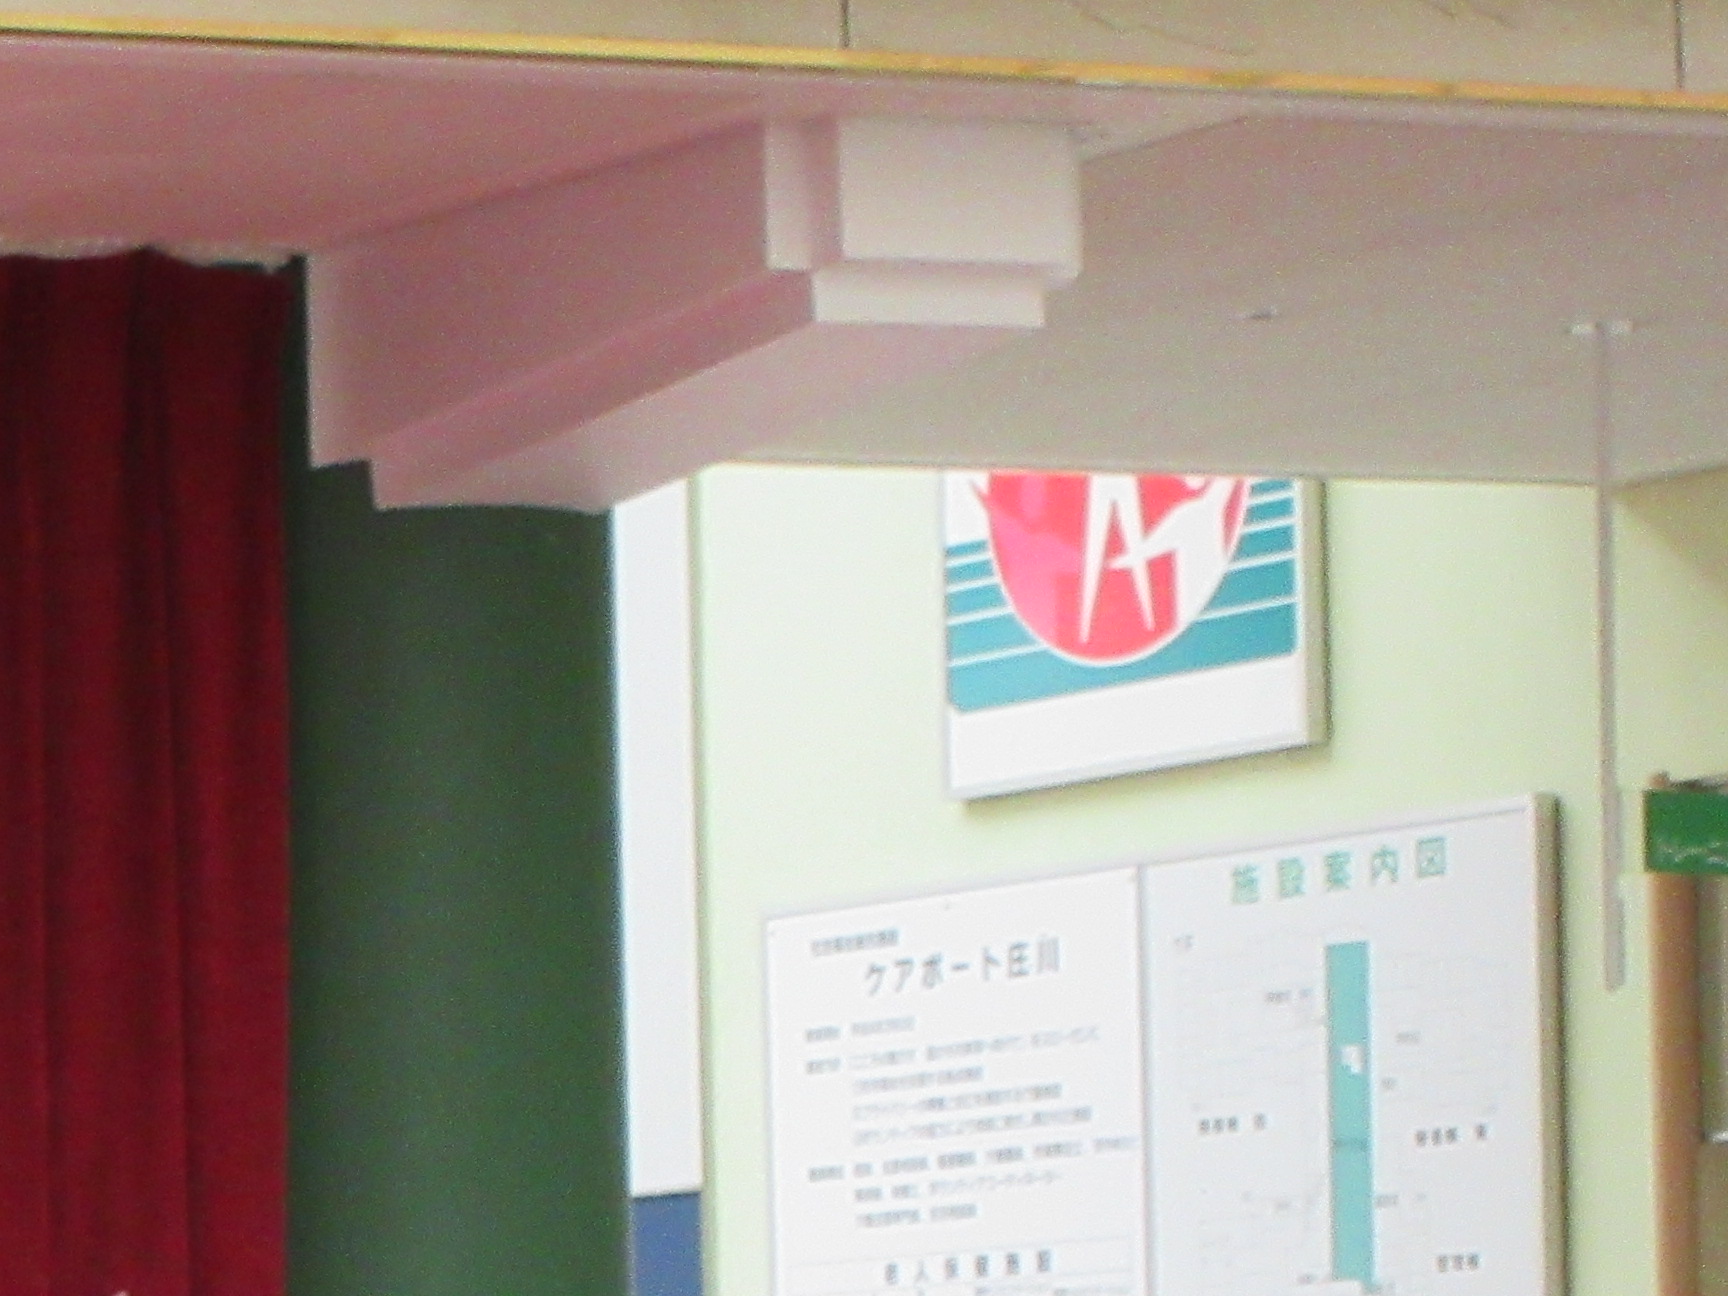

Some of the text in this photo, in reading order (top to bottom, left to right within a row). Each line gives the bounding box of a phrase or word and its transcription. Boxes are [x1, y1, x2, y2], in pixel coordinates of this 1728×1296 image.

[1231, 836, 1447, 904] 施設案内図
[865, 936, 1060, 996] ケアポート庄川
